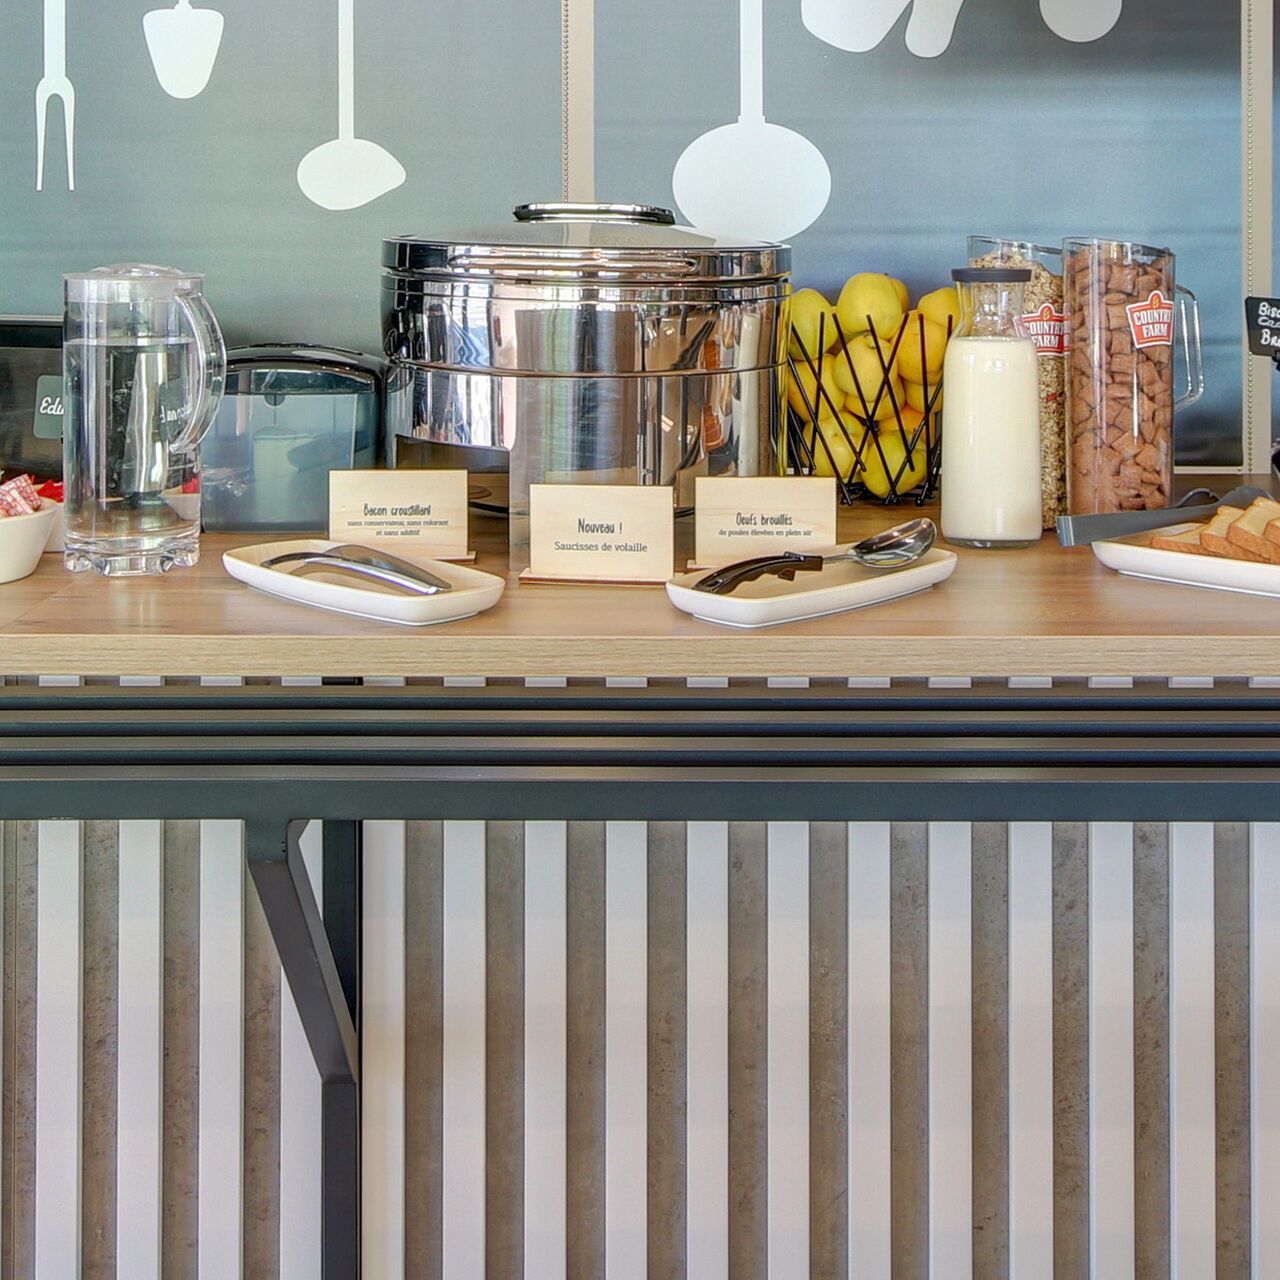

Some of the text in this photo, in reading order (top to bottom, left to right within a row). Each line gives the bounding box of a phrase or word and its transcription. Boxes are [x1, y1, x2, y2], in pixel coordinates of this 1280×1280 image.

[1142, 324, 1168, 338] FARM
[364, 503, 387, 516] Bacon
[578, 518, 614, 534] Nouveau
[736, 512, 757, 526] Oeufs
[555, 541, 648, 552] Saucisses de volaille
